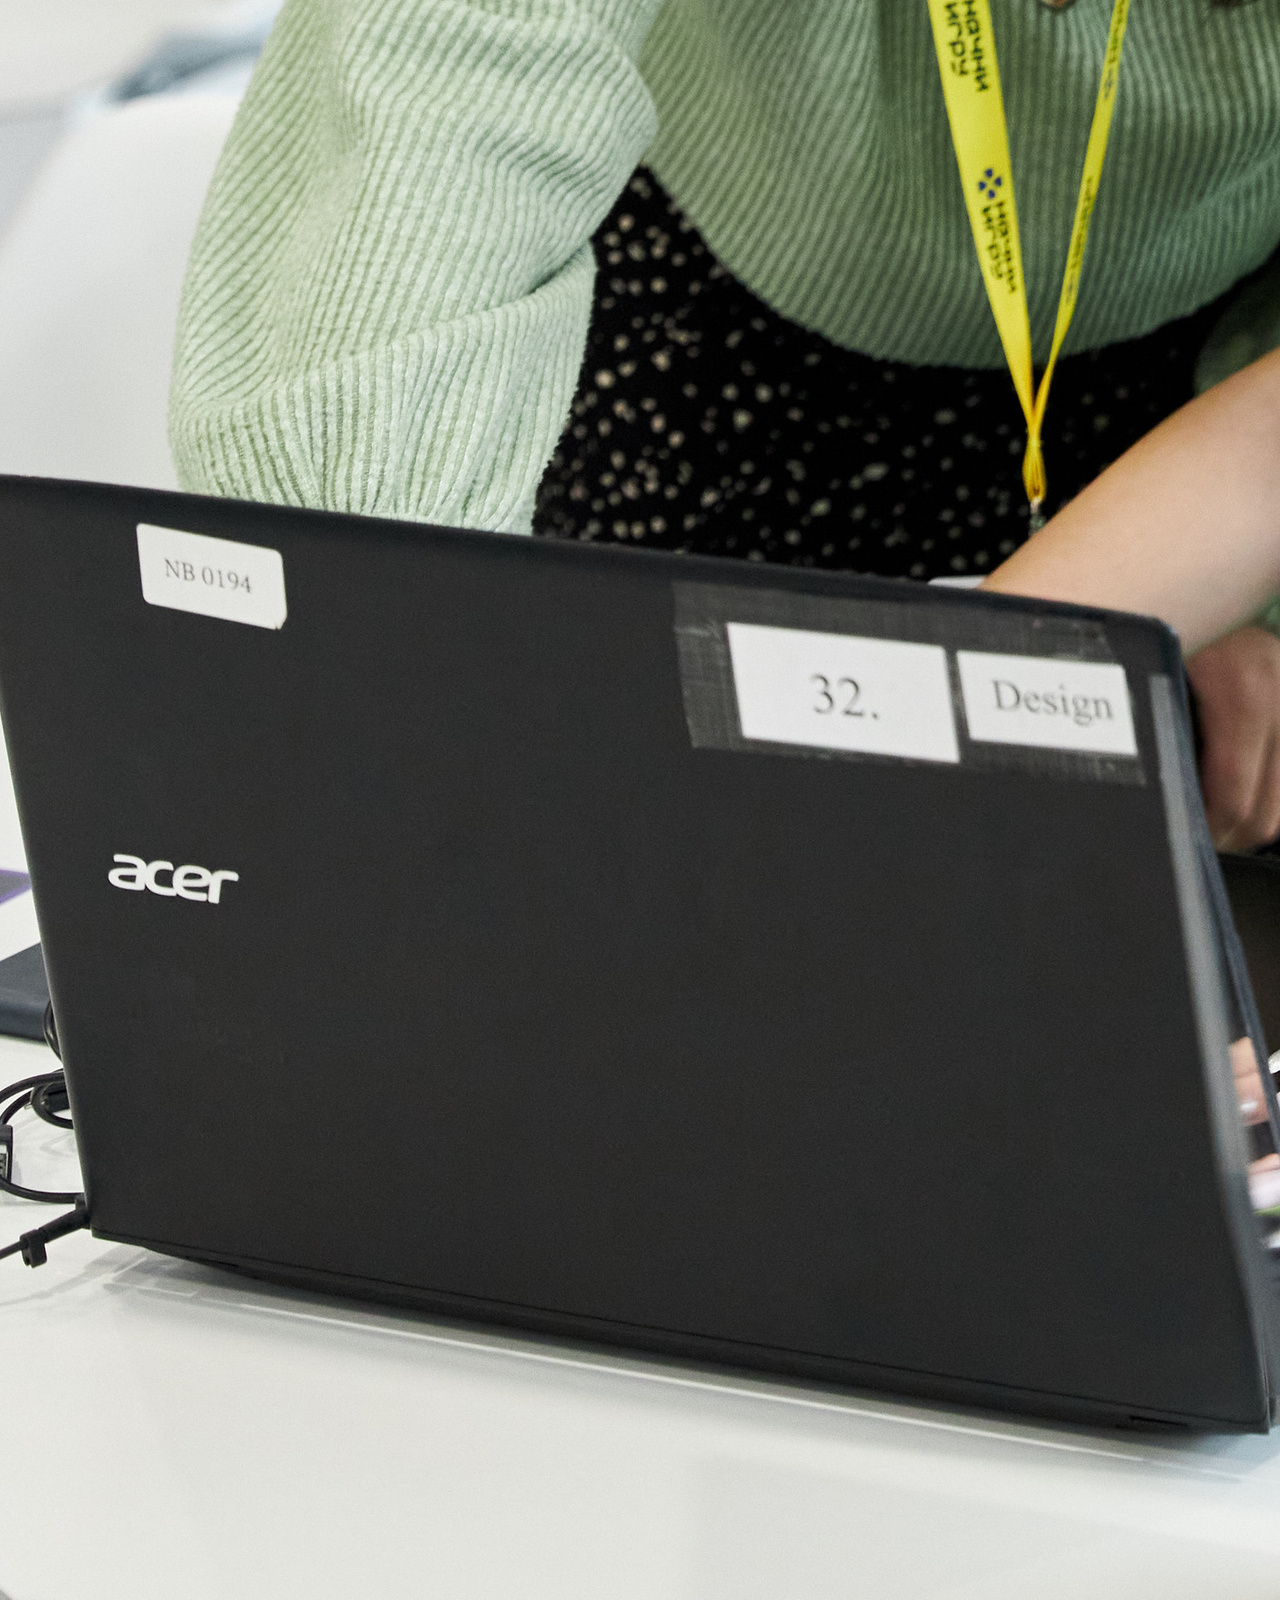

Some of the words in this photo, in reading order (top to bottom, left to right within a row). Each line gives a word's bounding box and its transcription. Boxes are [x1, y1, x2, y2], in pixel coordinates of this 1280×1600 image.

[163, 558, 196, 582] NB
[201, 566, 252, 594] 0194
[810, 673, 880, 721] 32.
[992, 678, 1116, 726] Design
[108, 853, 240, 904] acer
